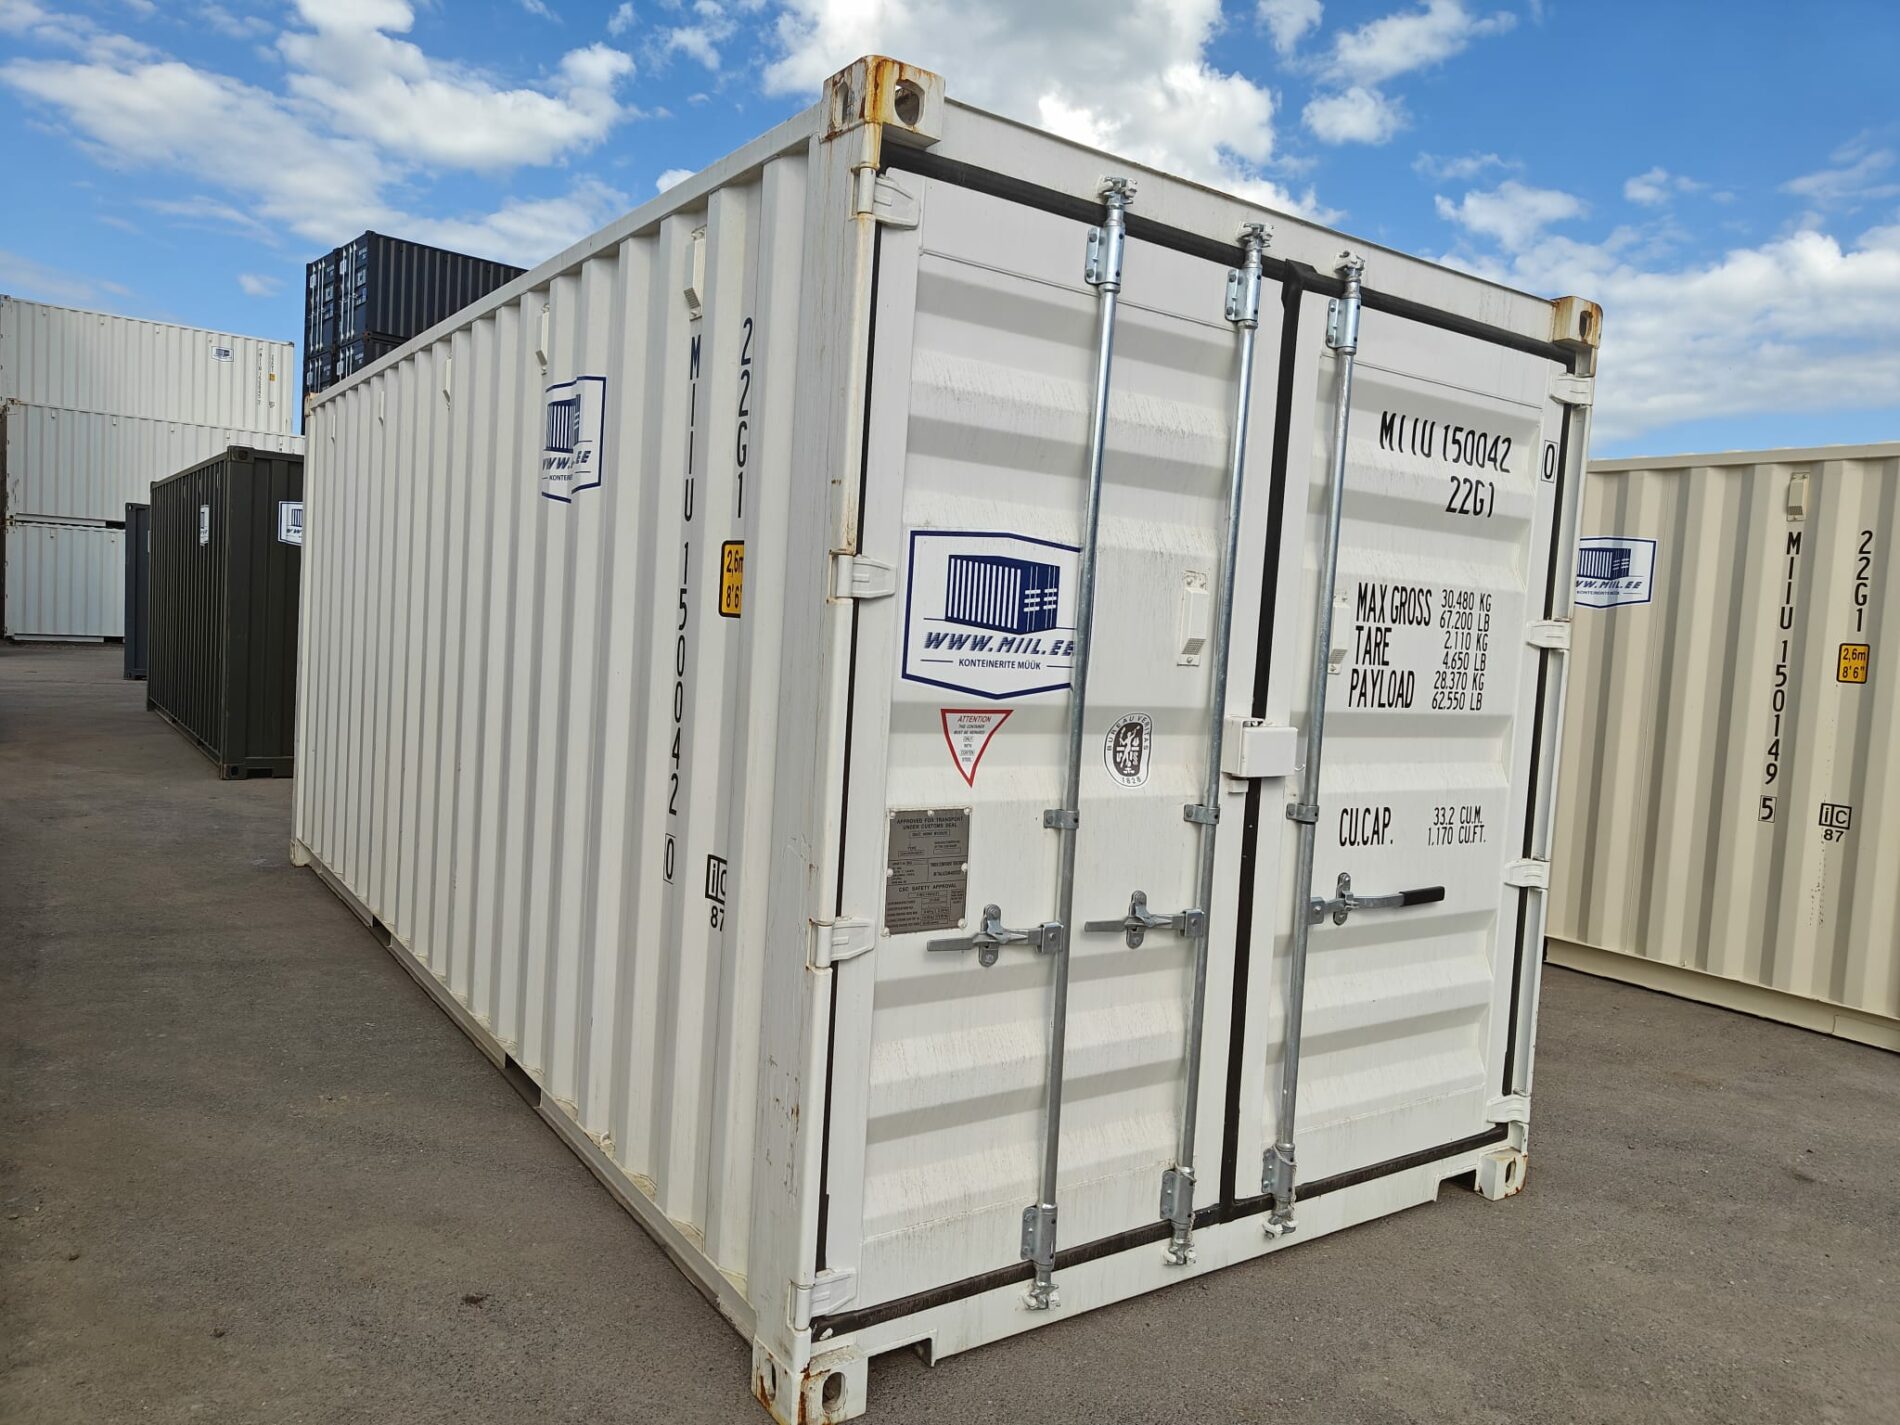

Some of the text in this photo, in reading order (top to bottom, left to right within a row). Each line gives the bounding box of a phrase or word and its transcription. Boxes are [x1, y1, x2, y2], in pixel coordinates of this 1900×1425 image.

[736, 317, 753, 518] 22G1
[1379, 411, 1555, 480] MIIU 150042 0
[1445, 475, 1495, 518] 22G1
[1855, 530, 1873, 632] 22G1
[666, 334, 701, 880] MIIU 150042 0
[1356, 582, 1387, 623] MAX
[1390, 585, 1432, 627] GROSS
[1479, 592, 1492, 612] KG
[1477, 612, 1490, 632] LB
[923, 631, 1075, 657] WWW.MIIL.EE
[1355, 625, 1392, 666] TARE
[1475, 632, 1489, 652] KG
[1842, 647, 1866, 662] 2,6m
[958, 658, 1041, 670] KONTEINERITE MÜÜK
[1474, 652, 1487, 672] LB
[1761, 531, 1802, 820] MIIU 150149 5
[1348, 668, 1415, 708] PAYLOAD
[1471, 671, 1485, 691] KG
[1469, 691, 1483, 711] LB
[957, 715, 992, 723] ATTENTION
[1433, 806, 1455, 825] 33.2
[1823, 829, 1844, 842] 87
